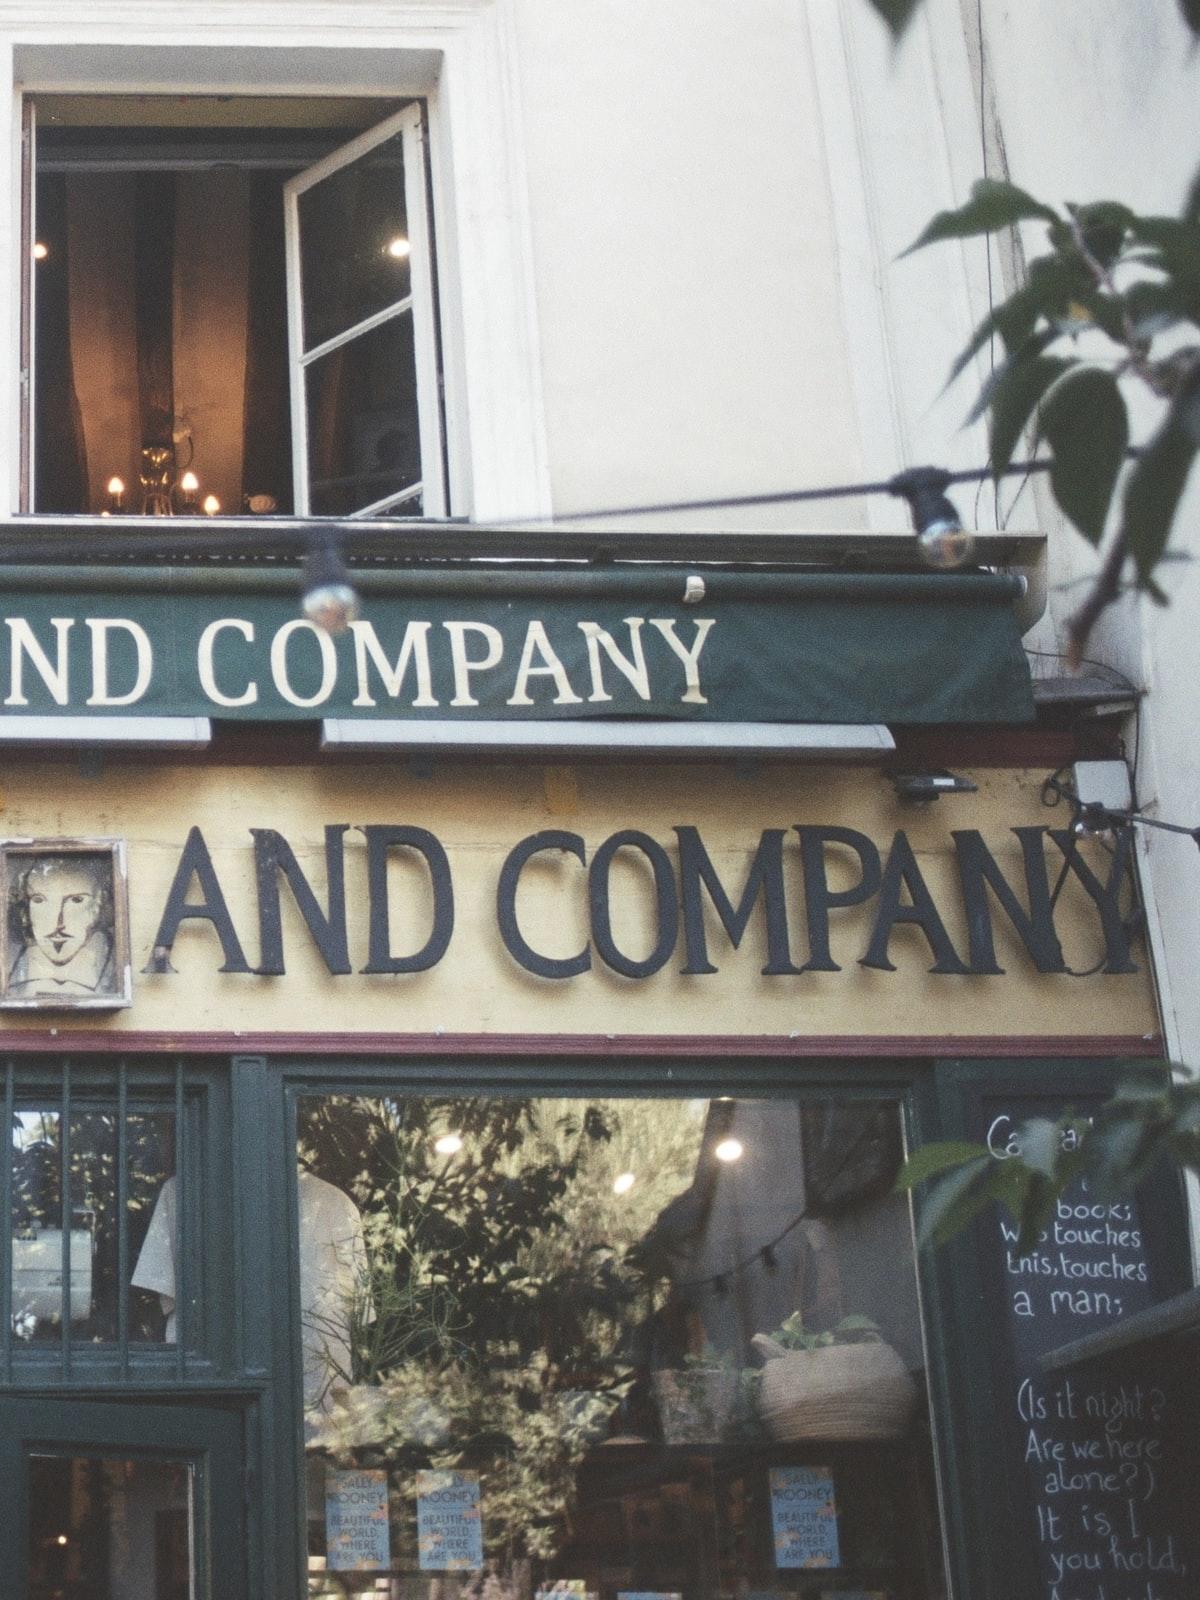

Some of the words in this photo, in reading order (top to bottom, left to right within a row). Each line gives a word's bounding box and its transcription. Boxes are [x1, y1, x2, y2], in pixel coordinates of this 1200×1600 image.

[197, 614, 717, 710] COMPANY
[142, 823, 455, 976] AND
[495, 823, 1146, 981] COMPANY
[1000, 1222, 1048, 1242] wo
[1054, 1221, 1141, 1248] touches
[1059, 1252, 1147, 1281] touches
[1014, 1290, 1035, 1316] a
[1050, 1289, 1123, 1315] man;
[1017, 1378, 1047, 1422] (Is
[1056, 1381, 1078, 1418] it
[1025, 1428, 1067, 1463] Are
[1072, 1440, 1104, 1459] we
[1105, 1433, 1163, 1459] here
[1045, 1462, 1154, 1501] alone?)
[1037, 1505, 1062, 1541] It
[1129, 1499, 1139, 1538] I
[1048, 1553, 1101, 1584] you
[1109, 1535, 1187, 1575] hold,
